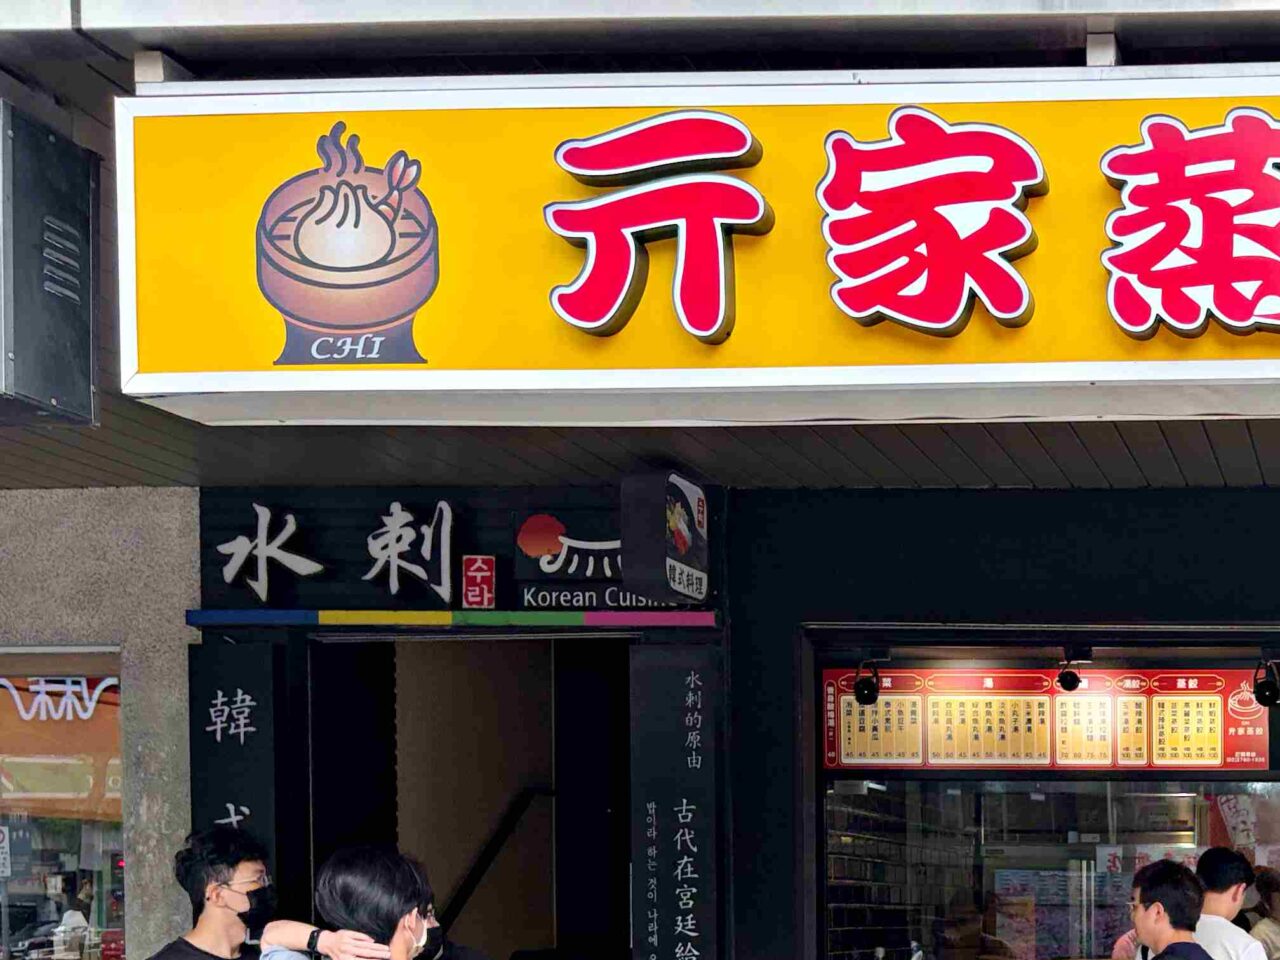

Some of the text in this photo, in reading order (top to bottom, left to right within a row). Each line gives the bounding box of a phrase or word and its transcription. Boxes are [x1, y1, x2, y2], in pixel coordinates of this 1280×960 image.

[311, 336, 382, 361] CHI
[523, 586, 678, 607] Korean Cuis
[1176, 678, 1199, 689] 蒸餃
